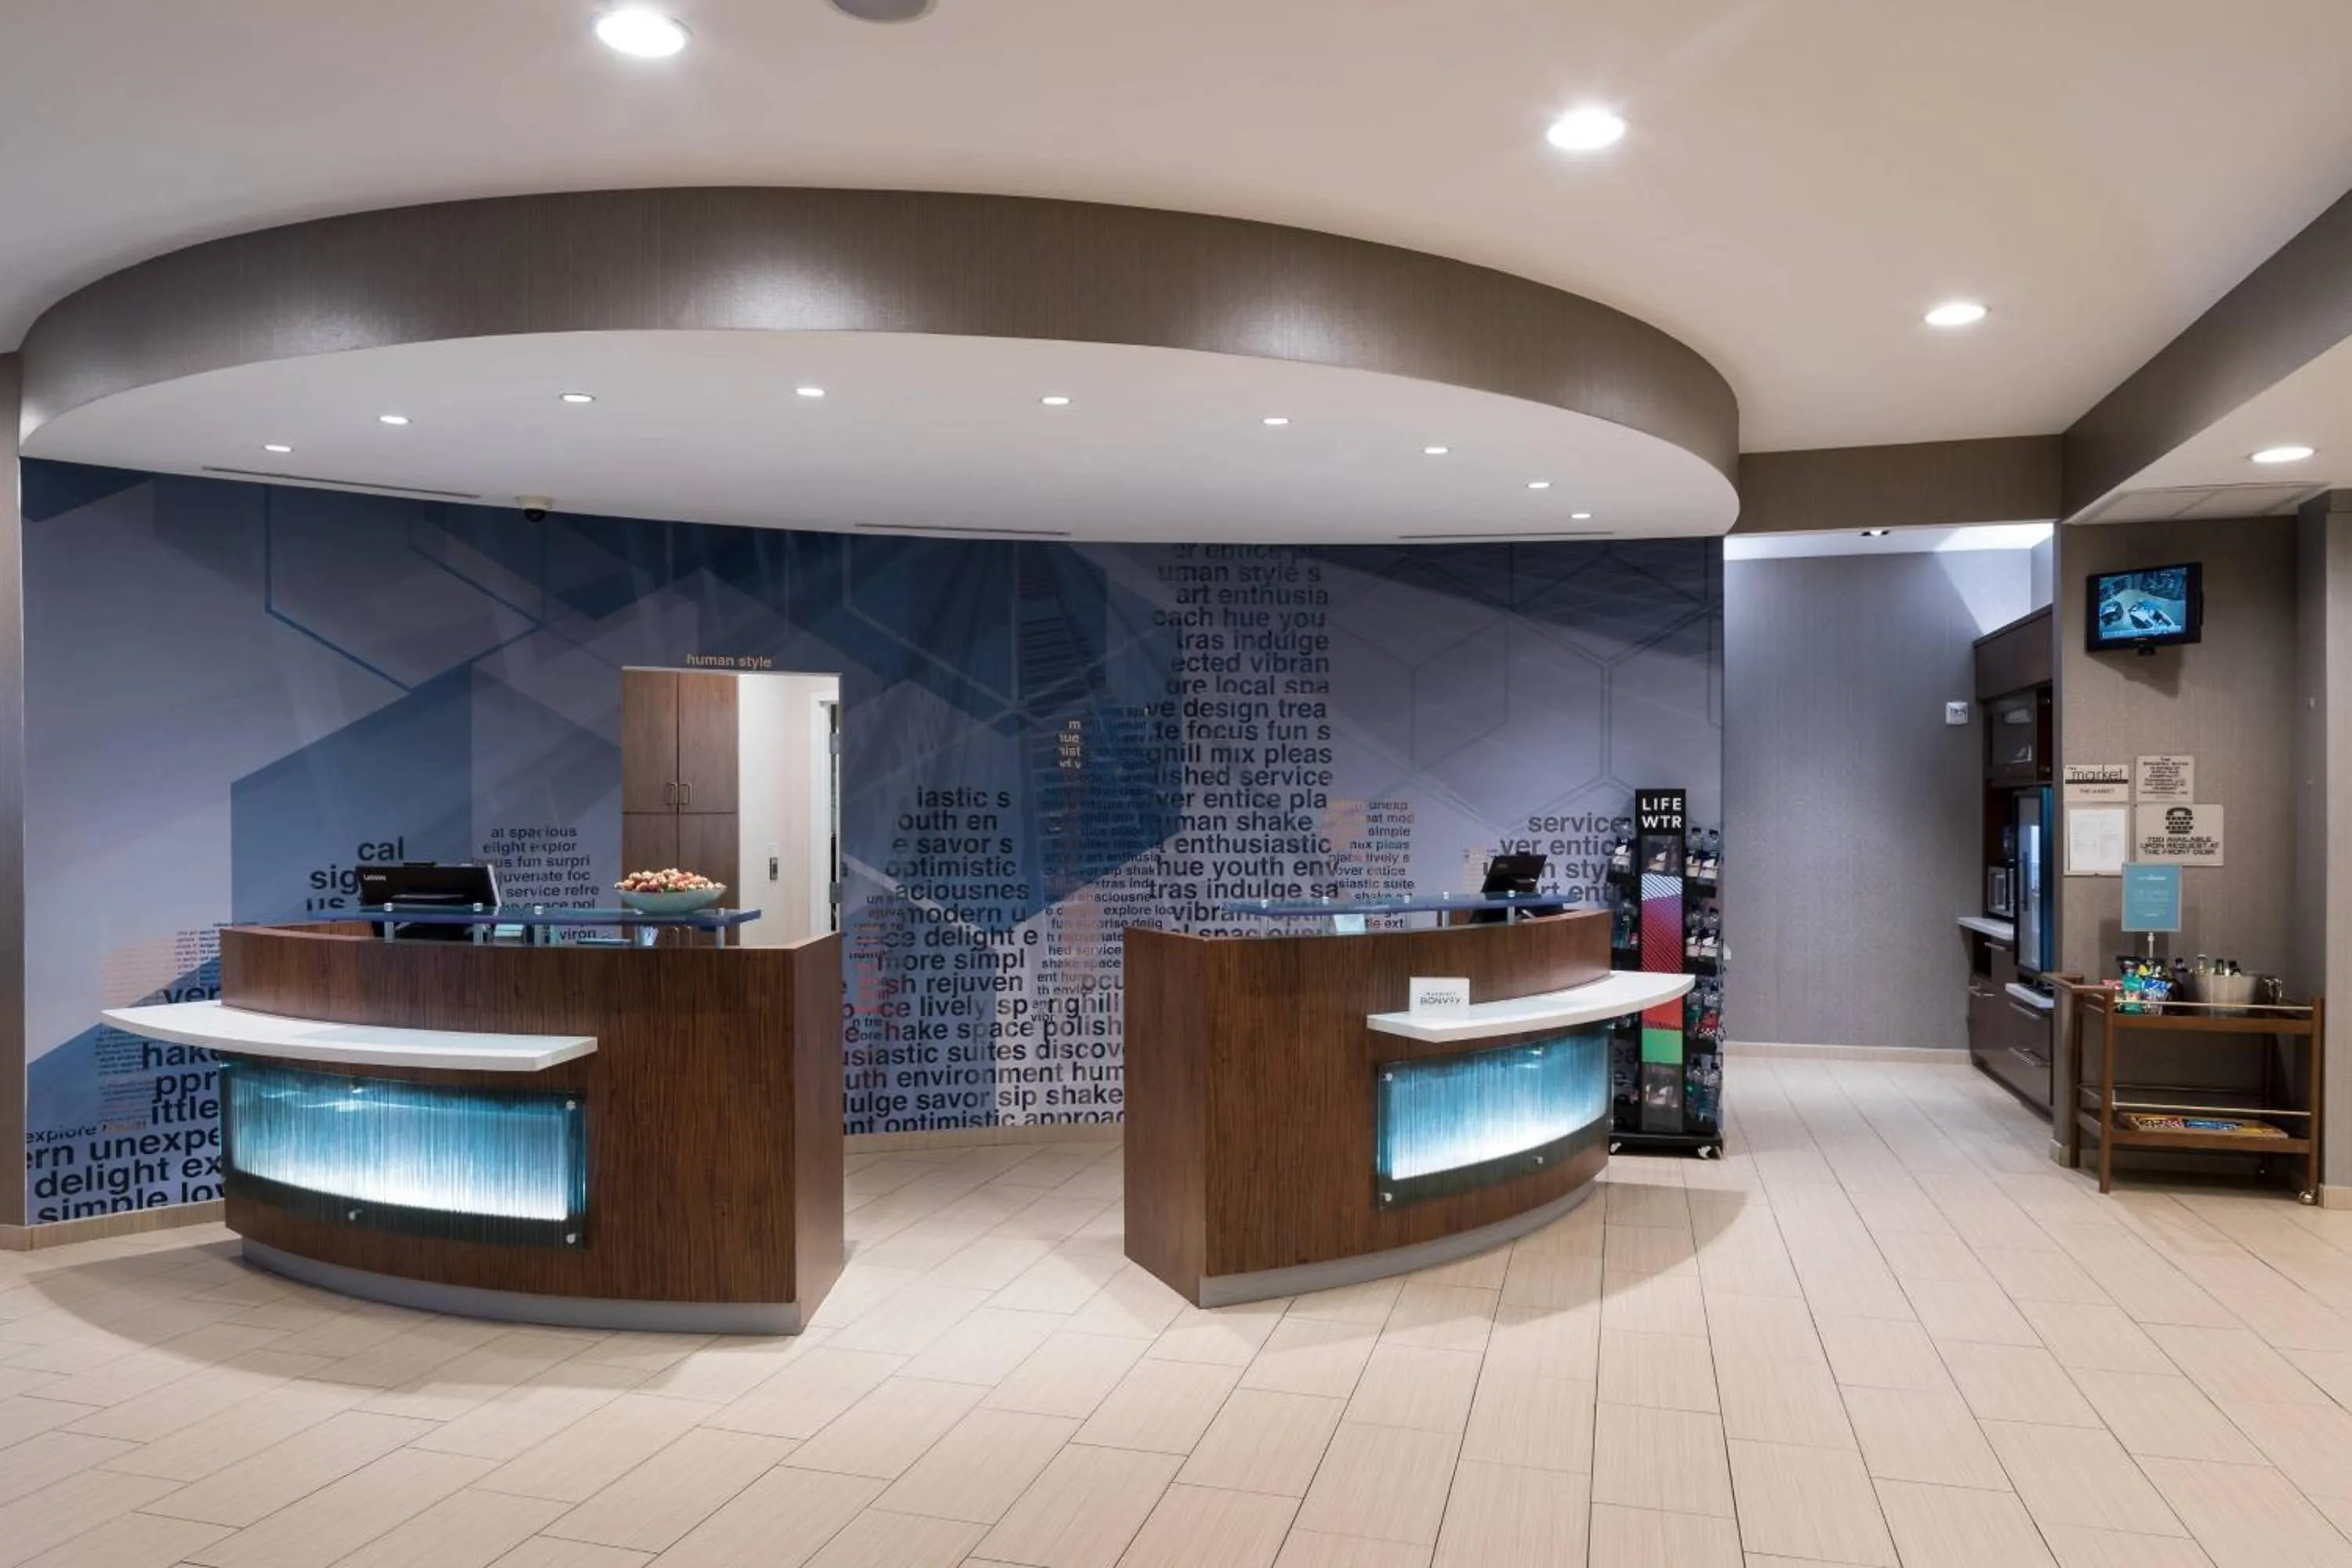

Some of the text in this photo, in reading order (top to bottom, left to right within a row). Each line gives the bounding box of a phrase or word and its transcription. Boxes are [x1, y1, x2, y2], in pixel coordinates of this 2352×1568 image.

[1177, 584, 1328, 605] art enthusia
[1223, 608, 1269, 626] hue
[1279, 611, 1325, 631] you
[1233, 630, 1330, 655] indulge
[686, 653, 773, 669] human style
[1171, 652, 1330, 673] ected vibran
[1215, 675, 1275, 695] local
[1183, 699, 1268, 722] design
[1279, 699, 1327, 718] trea
[1188, 720, 1258, 740] focus
[1267, 720, 1307, 740] fun
[1210, 745, 1255, 764] mix
[1265, 743, 1332, 767] pleas
[1240, 765, 1332, 786] service
[2072, 765, 2123, 780] market
[917, 785, 1011, 808] iastic s
[1203, 789, 1281, 808] entice
[1290, 789, 1327, 818] pla
[1642, 797, 1682, 811] LIFE
[898, 811, 997, 831] outh en
[1236, 811, 1312, 831] shake
[1368, 826, 1410, 837] simple
[1642, 815, 1682, 828] WTR
[510, 826, 577, 840] spacious
[1175, 833, 1332, 854] enthusiastic
[357, 836, 405, 861] cal
[917, 837, 990, 854] savor
[1000, 837, 1013, 854] s
[517, 855, 590, 869] fun surpri
[1156, 854, 1339, 881] hue youth env
[1365, 851, 1399, 866] lively
[309, 864, 359, 894] sig
[568, 869, 590, 881] foc
[1367, 865, 1406, 877] entice
[506, 884, 599, 897] service refre
[895, 881, 1029, 901] aciousnes
[1149, 877, 1339, 900] tras indulge sa
[1383, 879, 1415, 890] suite
[905, 902, 1025, 924] modern u
[1103, 905, 1152, 917] explore
[883, 930, 916, 948] ce
[924, 925, 1014, 952] delight
[1024, 929, 1038, 946] e
[877, 949, 1025, 972] more simpl
[884, 974, 916, 995] sh
[927, 972, 1024, 998] rejuven
[880, 1000, 911, 1018] ce
[920, 996, 985, 1020] lively
[845, 1017, 1122, 1044] e hake space polish
[947, 1042, 1026, 1062] suites
[154, 1069, 217, 1102] ppr
[845, 1069, 886, 1089] uth
[897, 1064, 1064, 1087] environment
[916, 1091, 990, 1109] savor
[999, 1086, 1036, 1112] sip
[1046, 1084, 1123, 1105] shake
[151, 1095, 220, 1126] ittle
[884, 1110, 1015, 1132] optimistic
[27, 1123, 97, 1143] explore
[34, 1156, 170, 1199] delight
[37, 1186, 169, 1225] simple
